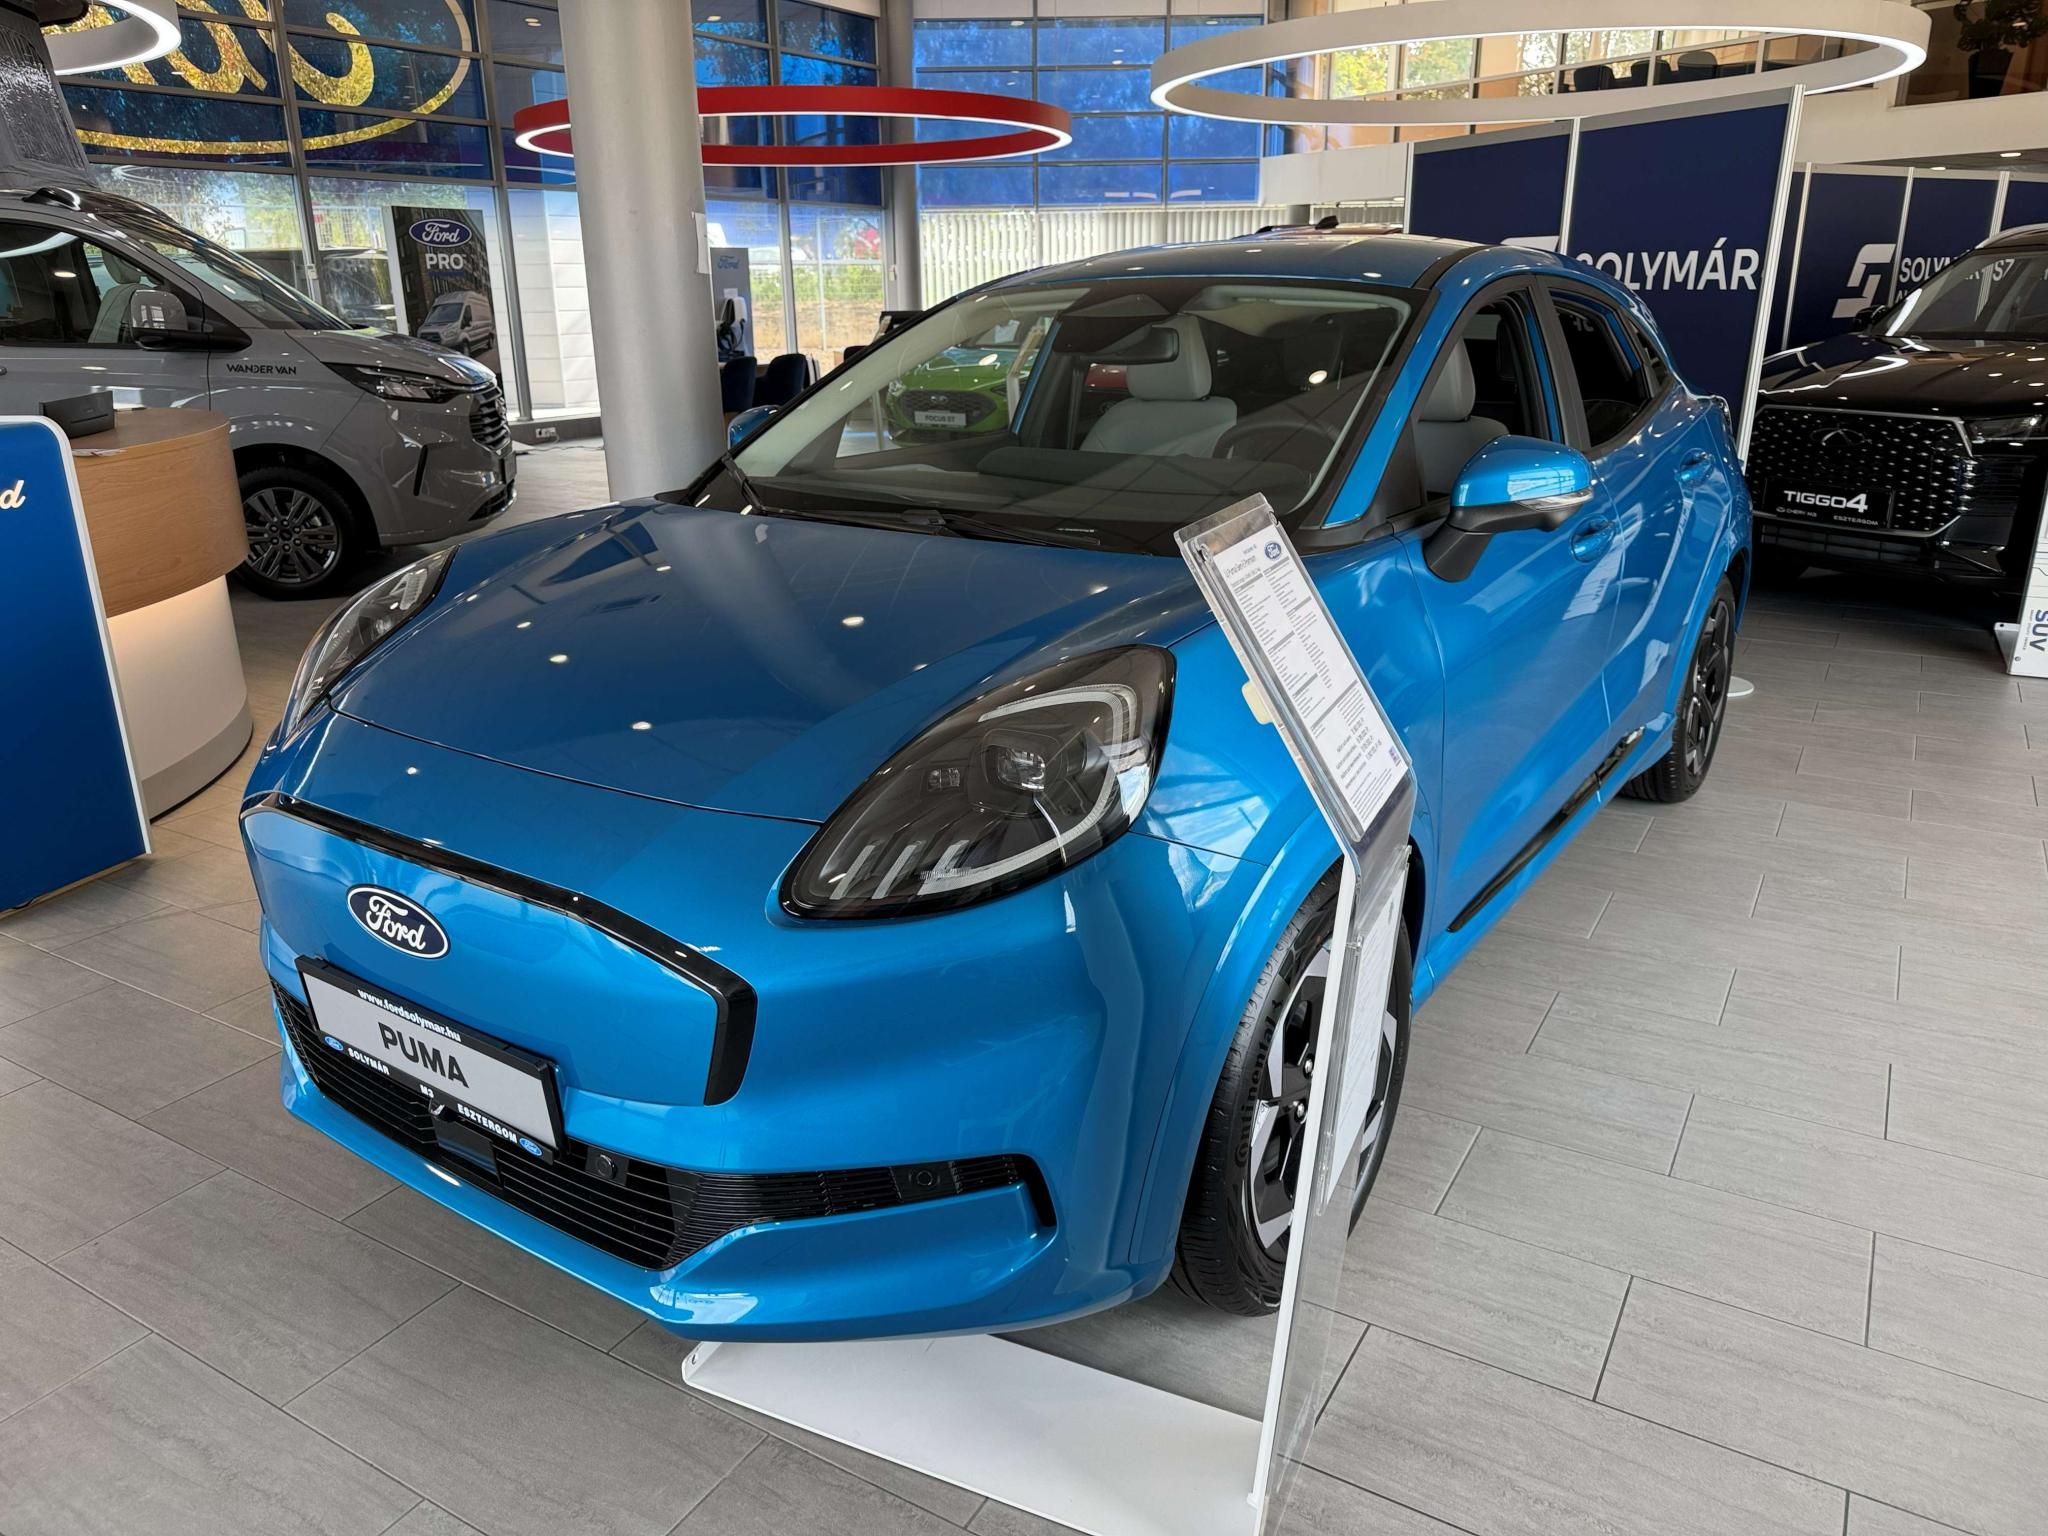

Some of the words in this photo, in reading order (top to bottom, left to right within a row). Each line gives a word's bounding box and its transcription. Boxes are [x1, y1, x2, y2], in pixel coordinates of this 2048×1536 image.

[422, 222, 460, 242] Ford
[425, 253, 463, 270] PRO
[226, 363, 273, 374] WANDER
[275, 366, 297, 375] VAN
[1833, 514, 1878, 526] ESZTERGOM
[2029, 609, 2048, 652] SUV
[366, 895, 426, 950] Ford
[358, 989, 461, 1043] www.fordsolymar.hu
[347, 1048, 390, 1076] SOLYMÁR
[378, 1022, 469, 1088] PUMA
[420, 1084, 434, 1098] M3
[457, 1103, 518, 1144] ESZTERGOM
